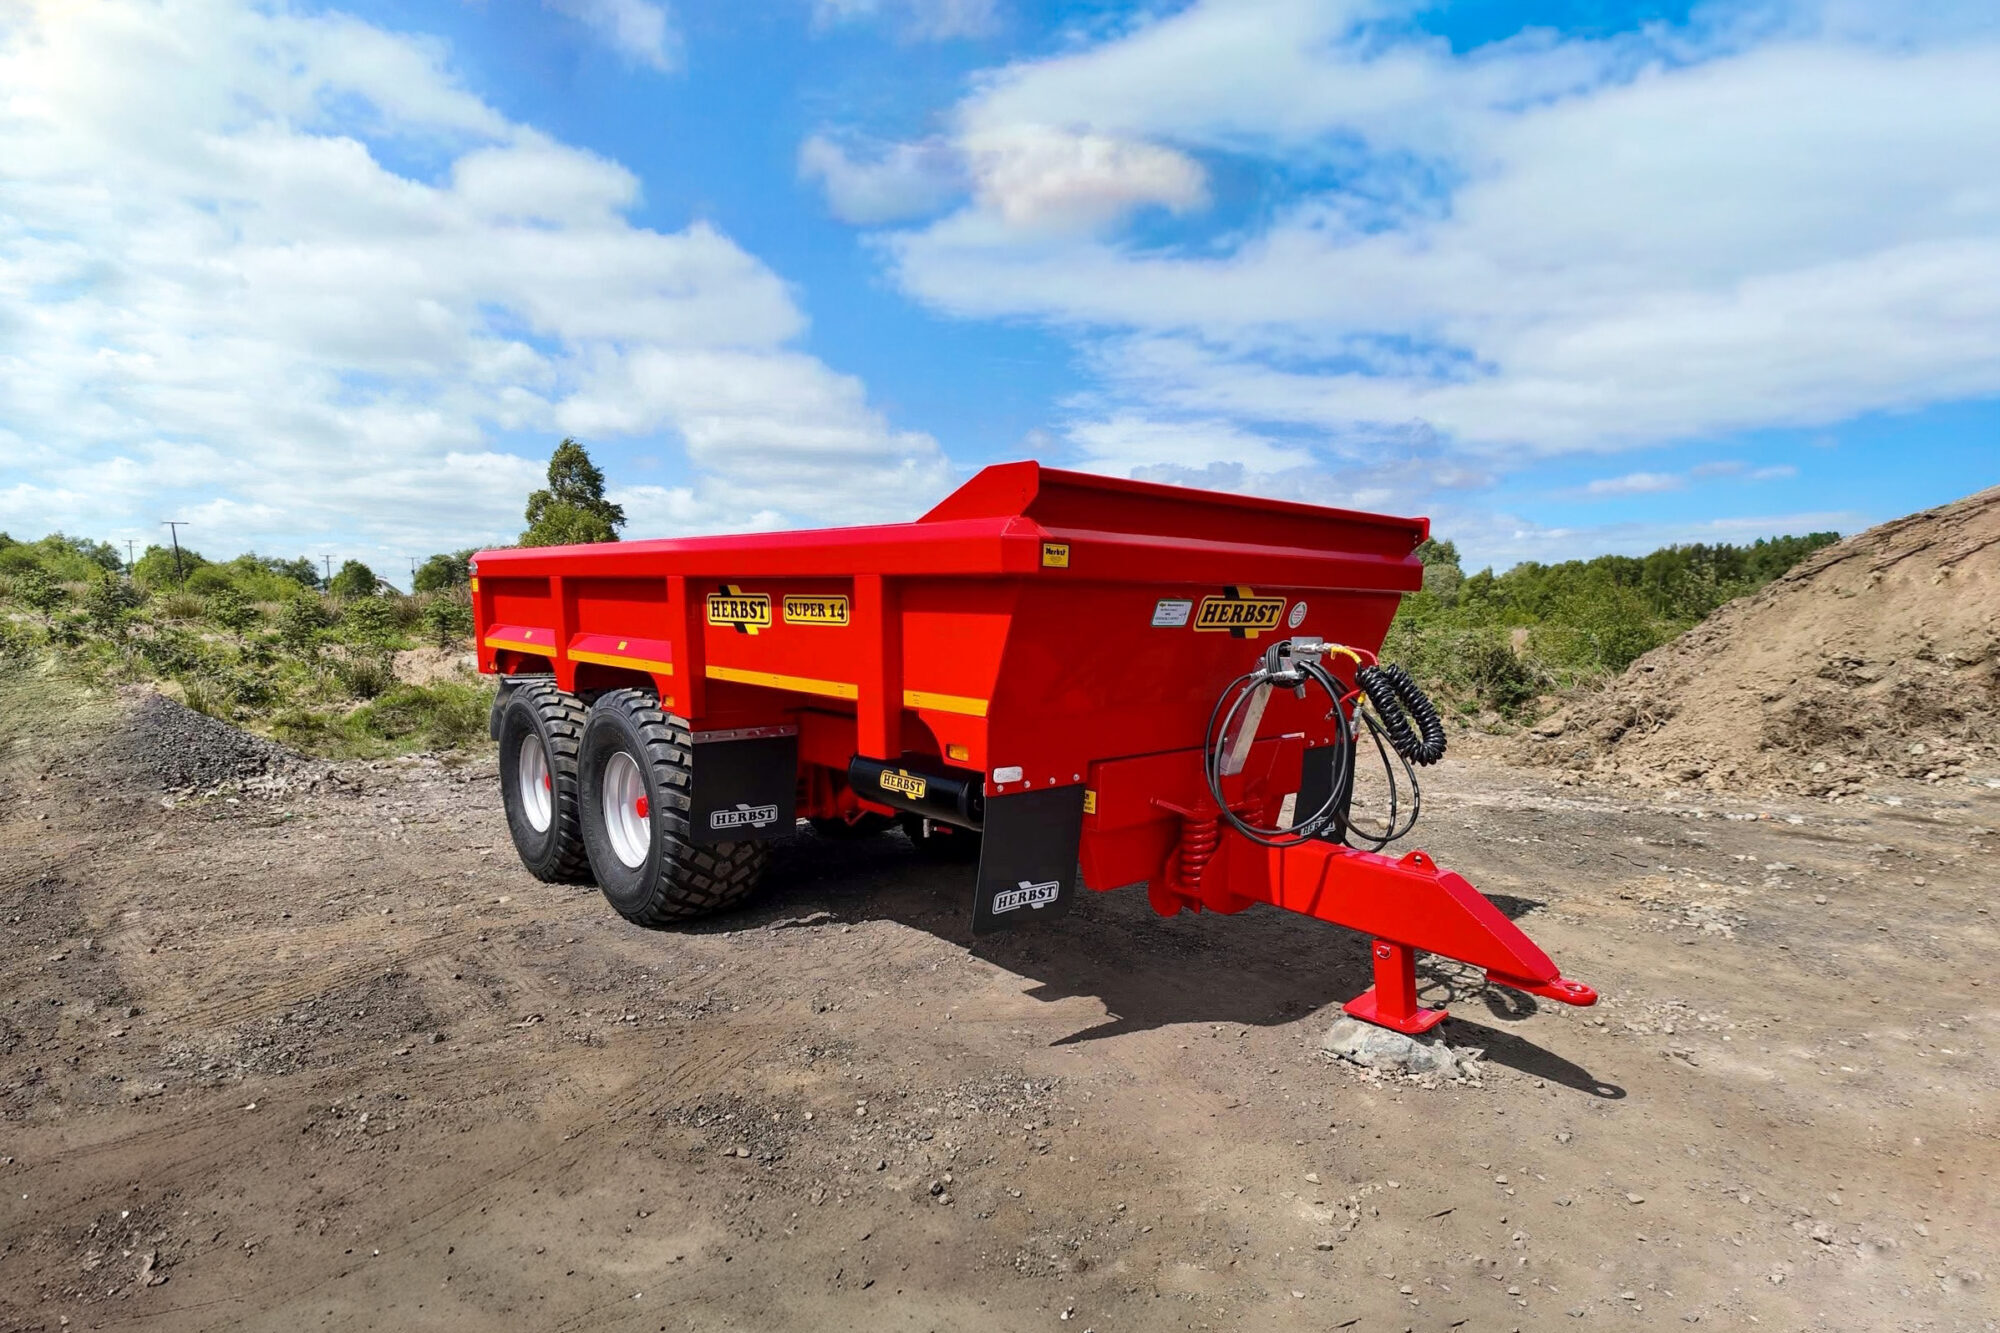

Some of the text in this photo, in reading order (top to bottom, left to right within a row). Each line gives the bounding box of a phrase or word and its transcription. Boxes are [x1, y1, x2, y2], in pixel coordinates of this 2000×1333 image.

[711, 600, 767, 619] HERBST
[787, 602, 845, 620] SUPER 14
[1201, 603, 1281, 623] HERBST
[883, 774, 923, 793] HERBST
[715, 808, 775, 825] HERBST
[996, 885, 1056, 909] HERBST
